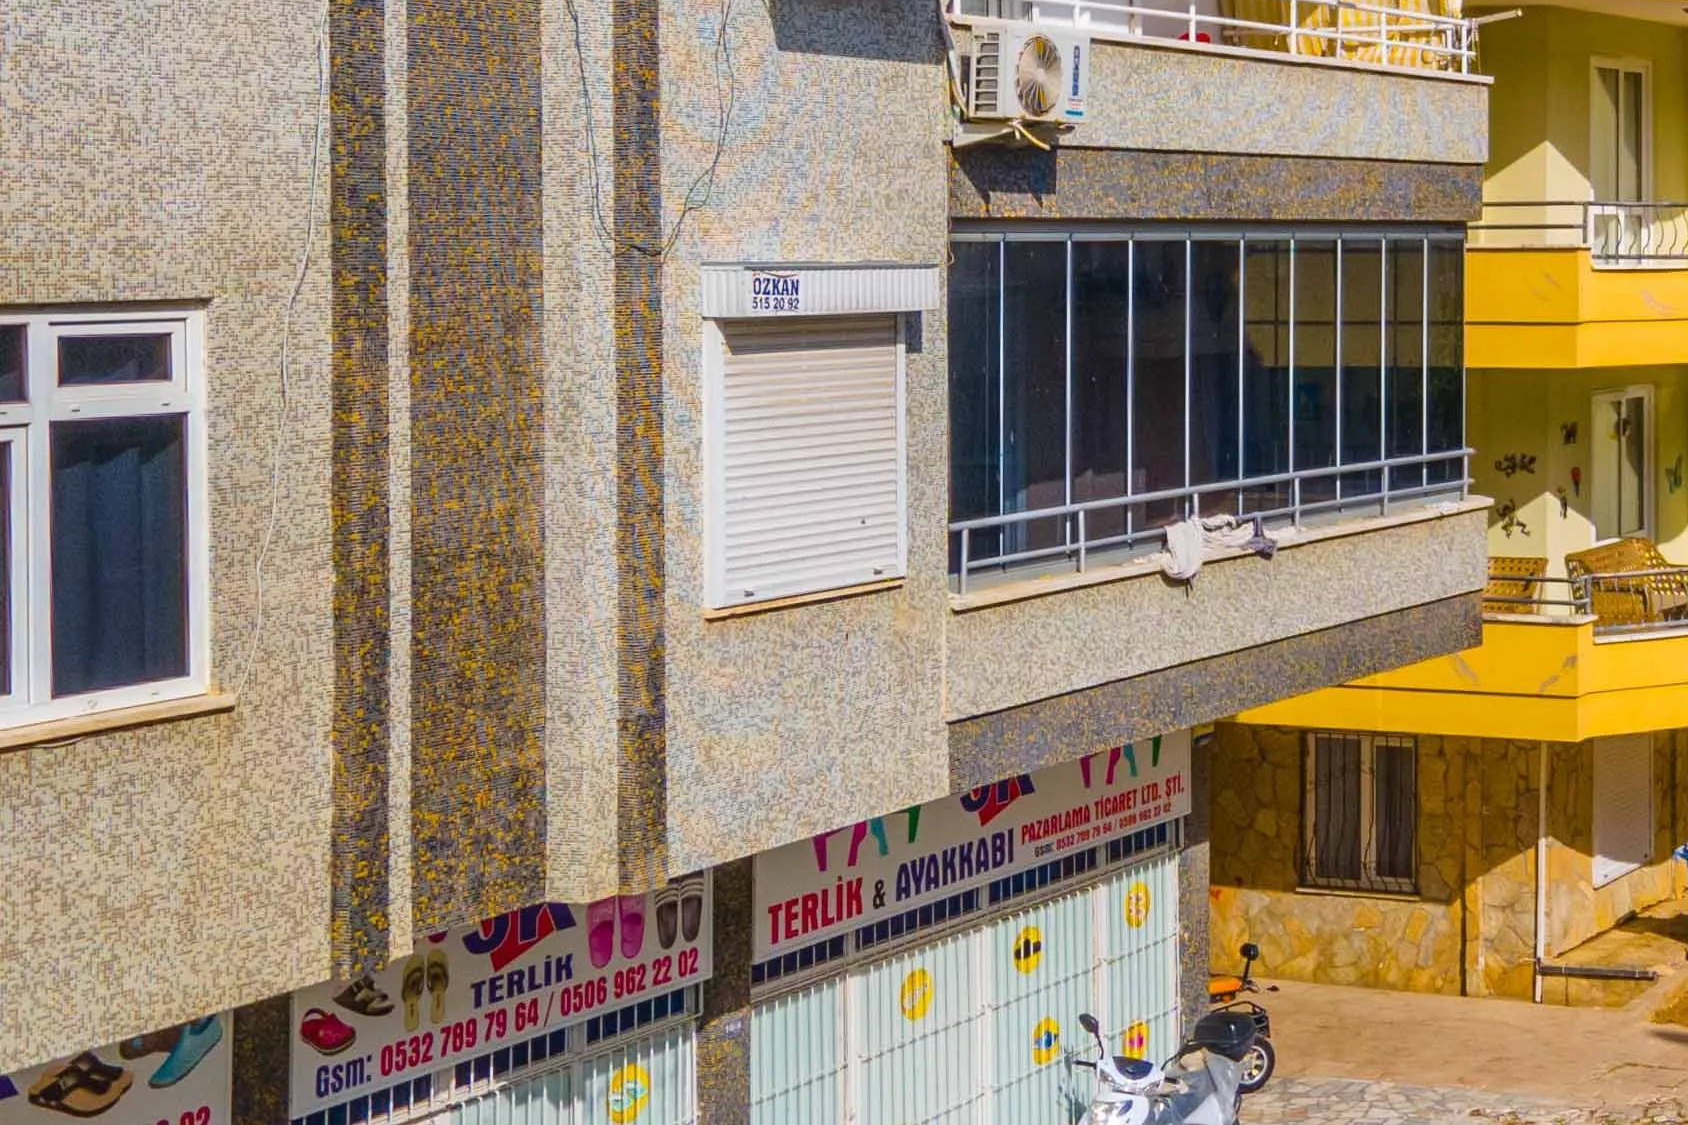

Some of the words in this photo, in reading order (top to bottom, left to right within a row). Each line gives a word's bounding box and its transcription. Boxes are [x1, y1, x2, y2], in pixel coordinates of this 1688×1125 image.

[752, 296, 770, 310] 515
[773, 297, 785, 310] 20
[787, 297, 800, 310] 92
[1021, 804, 1091, 845] PAZARLAMA
[1094, 787, 1138, 821] TİCARET
[1141, 782, 1161, 805] LTD.
[768, 876, 864, 945] TERLİK
[873, 879, 886, 909] &
[896, 828, 1014, 902] AYAKKABI
[380, 1032, 434, 1077] 0532
[440, 1018, 477, 1057] 789
[484, 1007, 507, 1043] 79
[515, 997, 539, 1032] 64
[560, 976, 607, 1017] 0506
[614, 963, 646, 999] 962
[652, 955, 672, 987] 22
[678, 947, 699, 977] 02
[470, 953, 574, 1009] TERLİK
